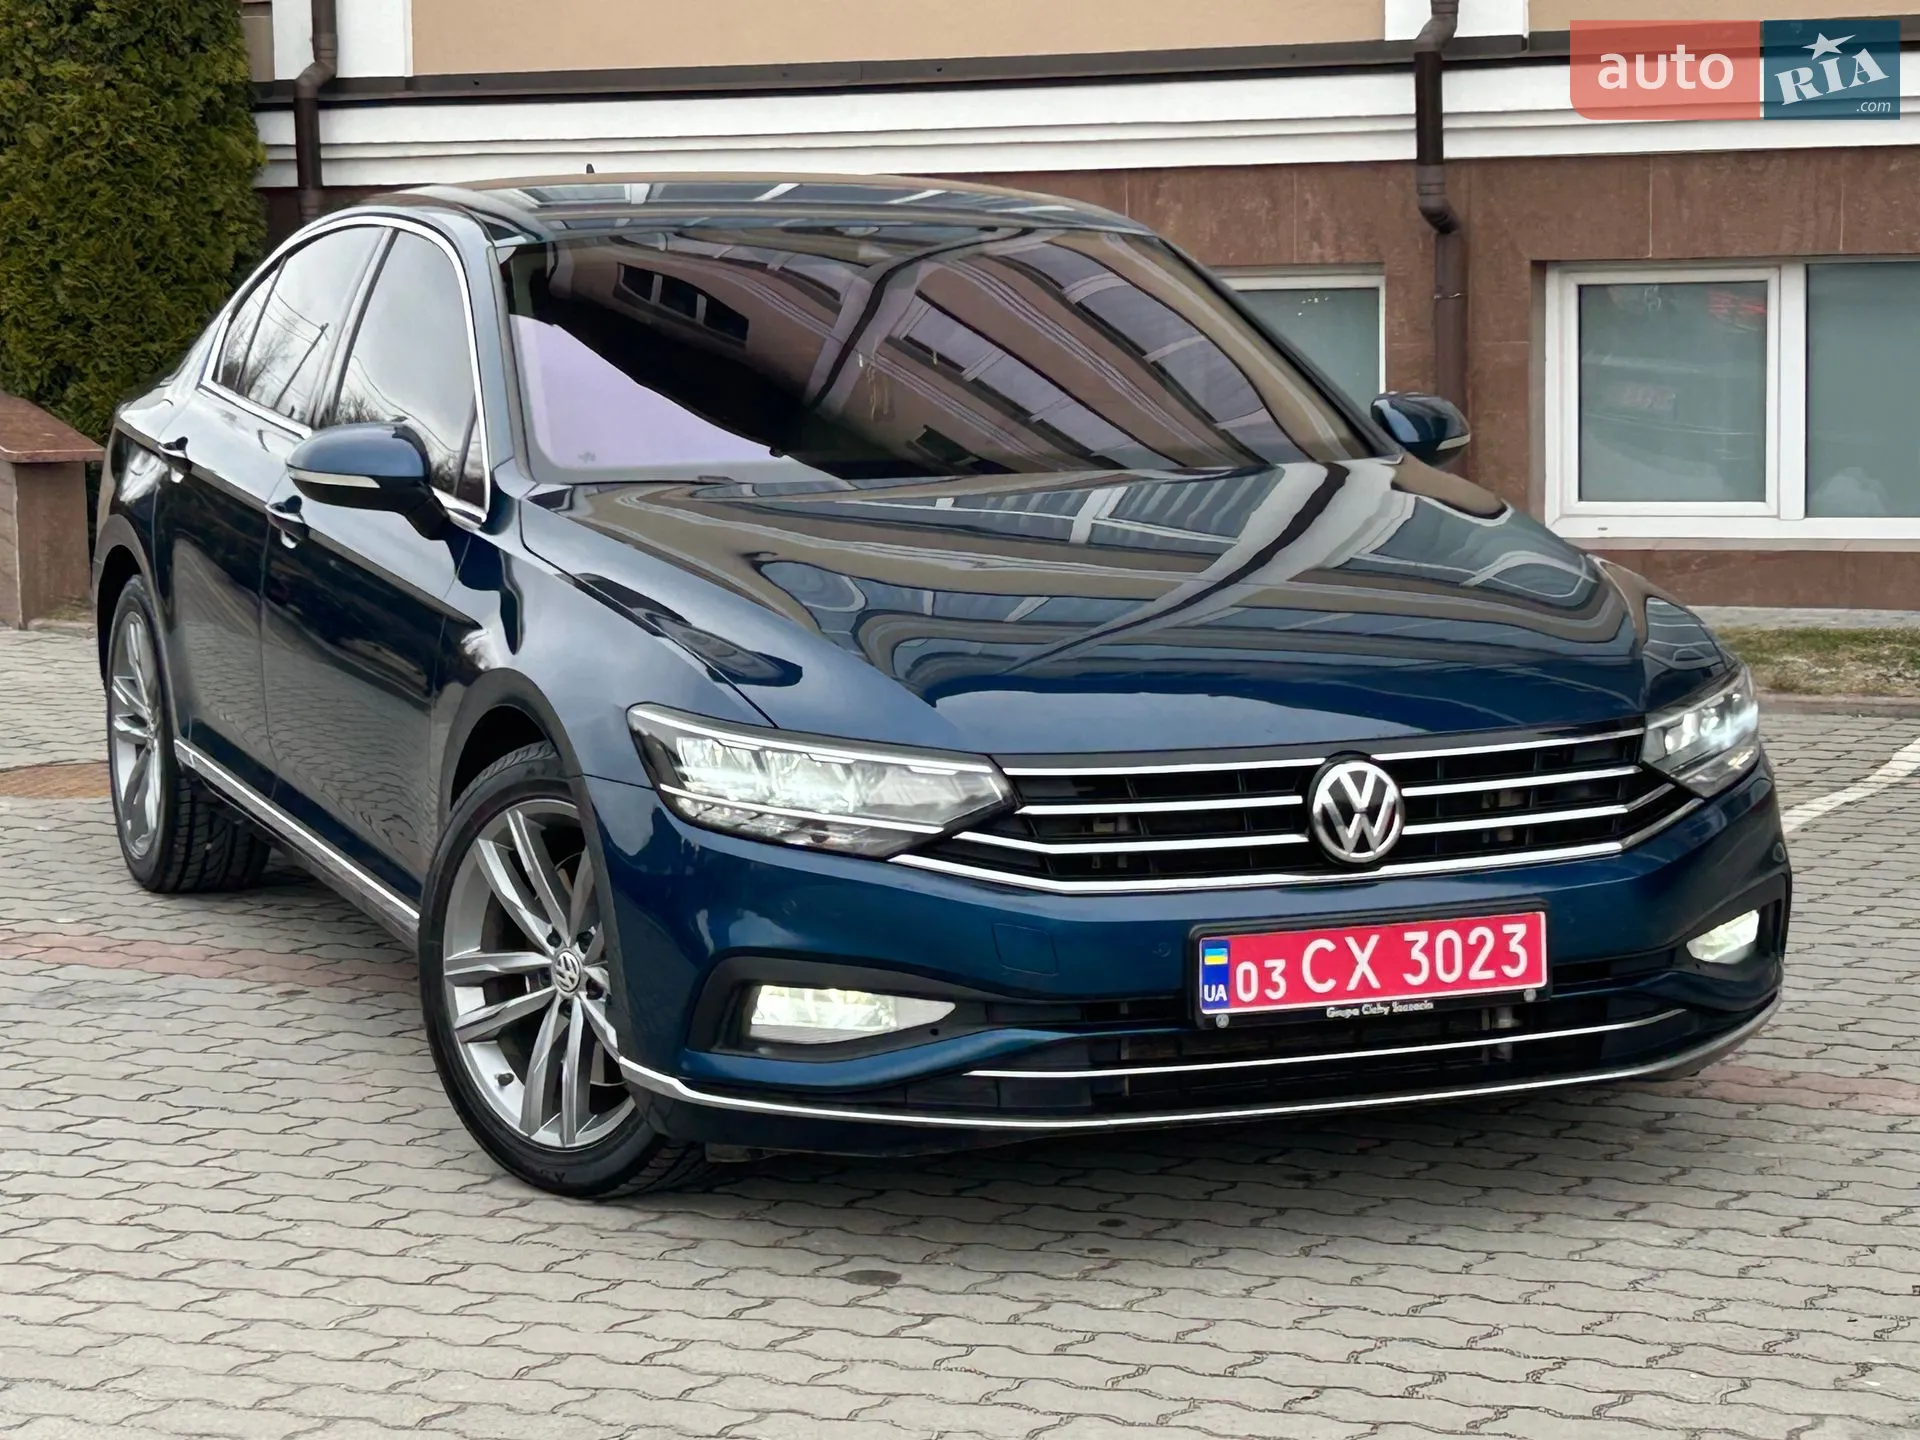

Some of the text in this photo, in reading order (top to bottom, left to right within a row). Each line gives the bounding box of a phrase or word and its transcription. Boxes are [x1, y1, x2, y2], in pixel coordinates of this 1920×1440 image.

[1314, 762, 1400, 862] VW
[1203, 984, 1228, 1002] UA
[1235, 923, 1528, 1002] 03 CX 3023
